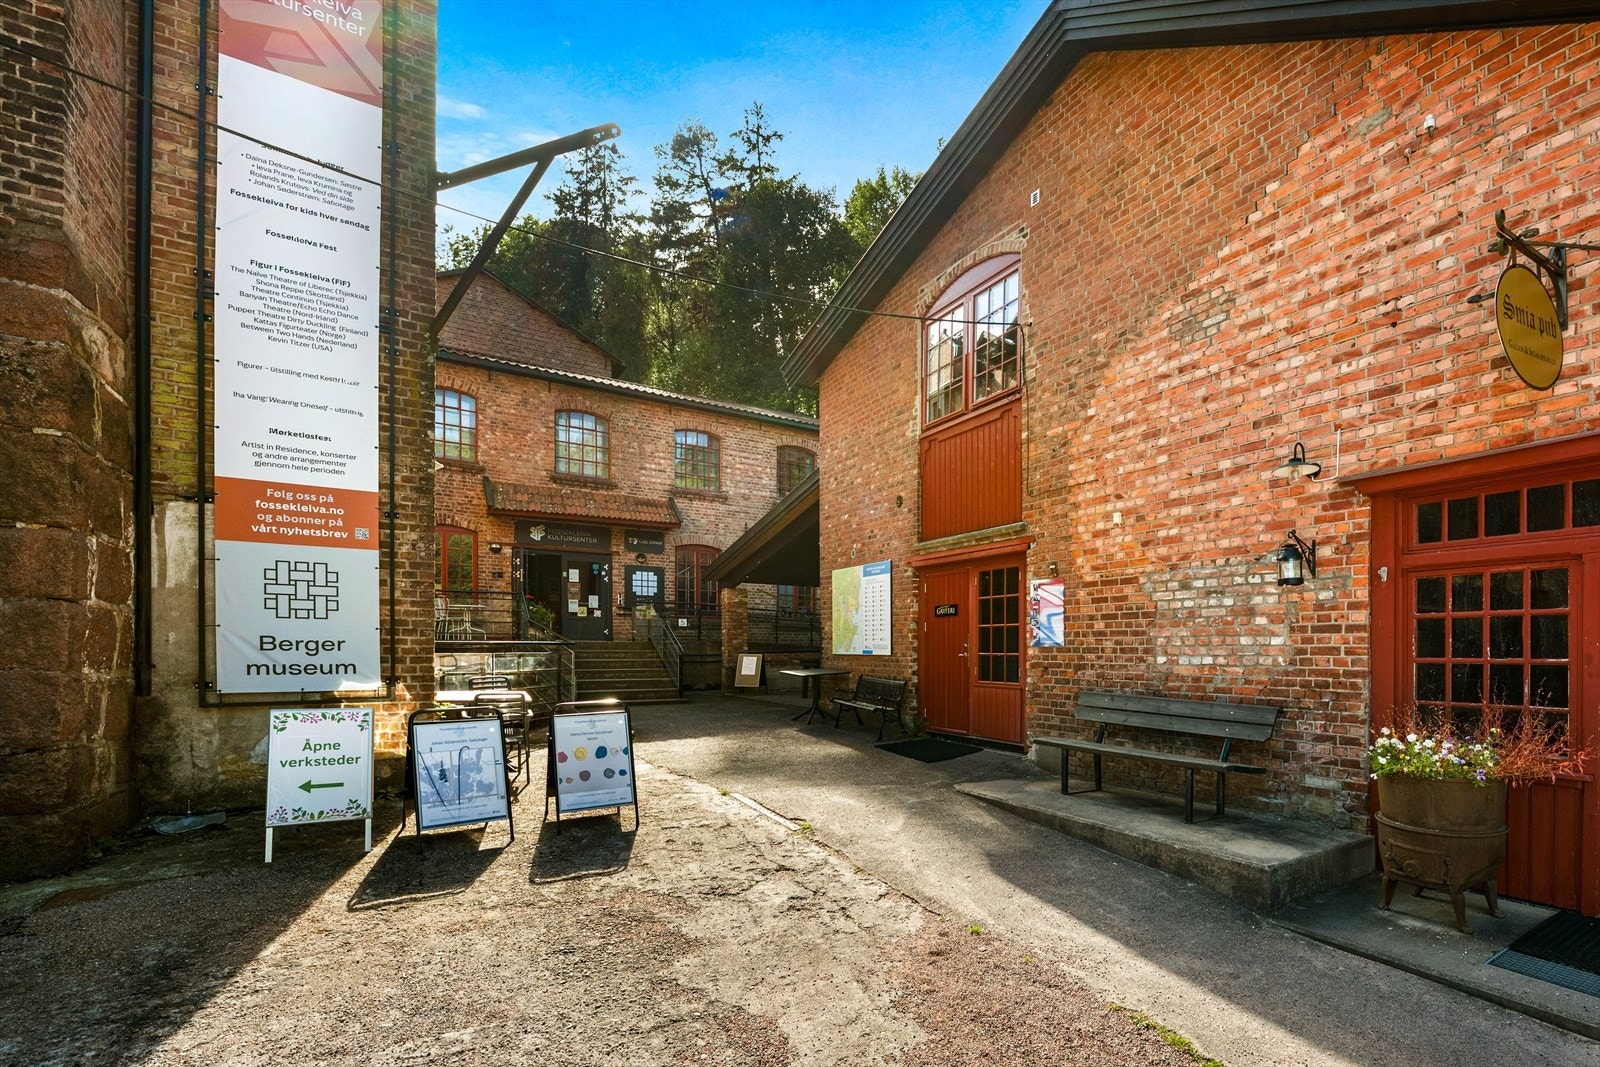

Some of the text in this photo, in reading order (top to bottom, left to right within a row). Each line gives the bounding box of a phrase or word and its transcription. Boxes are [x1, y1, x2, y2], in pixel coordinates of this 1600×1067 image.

[245, 153, 267, 165] Daina
[269, 159, 339, 184] Deksne-Gundersen:
[340, 180, 362, 191] Søstre
[256, 164, 272, 174] Ieva
[298, 175, 312, 185] Ieva
[313, 180, 343, 193] Krumina
[344, 189, 353, 197] og
[250, 170, 353, 203] Rolands Krutovs: Ved din side
[252, 179, 276, 190] Johan
[322, 197, 355, 211] Sabotage
[230, 188, 370, 231] Fossekleiva for kids hver søndag
[319, 242, 337, 252] Fest
[250, 259, 272, 270] Figur
[279, 266, 330, 283] Fossekleiva
[230, 265, 245, 273] The
[269, 274, 298, 285] Theatre
[308, 282, 333, 293] Liberec
[335, 288, 368, 301] (Tsjekkia)
[255, 278, 345, 303] Shona Reppe (Skottland)
[239, 290, 359, 320] Banyan Theatre/Echo Echo Dance
[251, 285, 349, 311] Theatre Continuo (Tsjekkia)
[228, 303, 369, 337] Puppet Theatre Dirty Duckling (Finland)
[262, 303, 339, 324] Theatre (Nord-Irland)
[1503, 293, 1557, 339] Smia pub
[240, 322, 358, 350] Between Two Hands (Nederland)
[254, 317, 346, 340] Kattas Figurteater (Norge)
[268, 335, 333, 353] Kevin Titzer (USA)
[237, 360, 263, 371] Figurer
[302, 372, 319, 380] med
[269, 396, 299, 408] Wearing
[300, 401, 328, 412] Oneself
[241, 440, 264, 450] Artist
[275, 444, 319, 457] Residence,
[320, 450, 357, 461] konserter
[264, 452, 288, 461] andre
[289, 456, 347, 468] arrangementer
[254, 460, 345, 476] gjennom hele perioden
[266, 488, 334, 504] Følg oss på
[255, 499, 345, 515] fossekleiva.no
[251, 523, 349, 538] vårt nyhetsbrev
[257, 513, 344, 527] og abonner på
[547, 534, 598, 544] KULTURSENTER
[259, 635, 346, 657] Berger
[246, 662, 357, 676] museum
[302, 738, 341, 754] Åpne
[279, 754, 362, 768] verksteder
